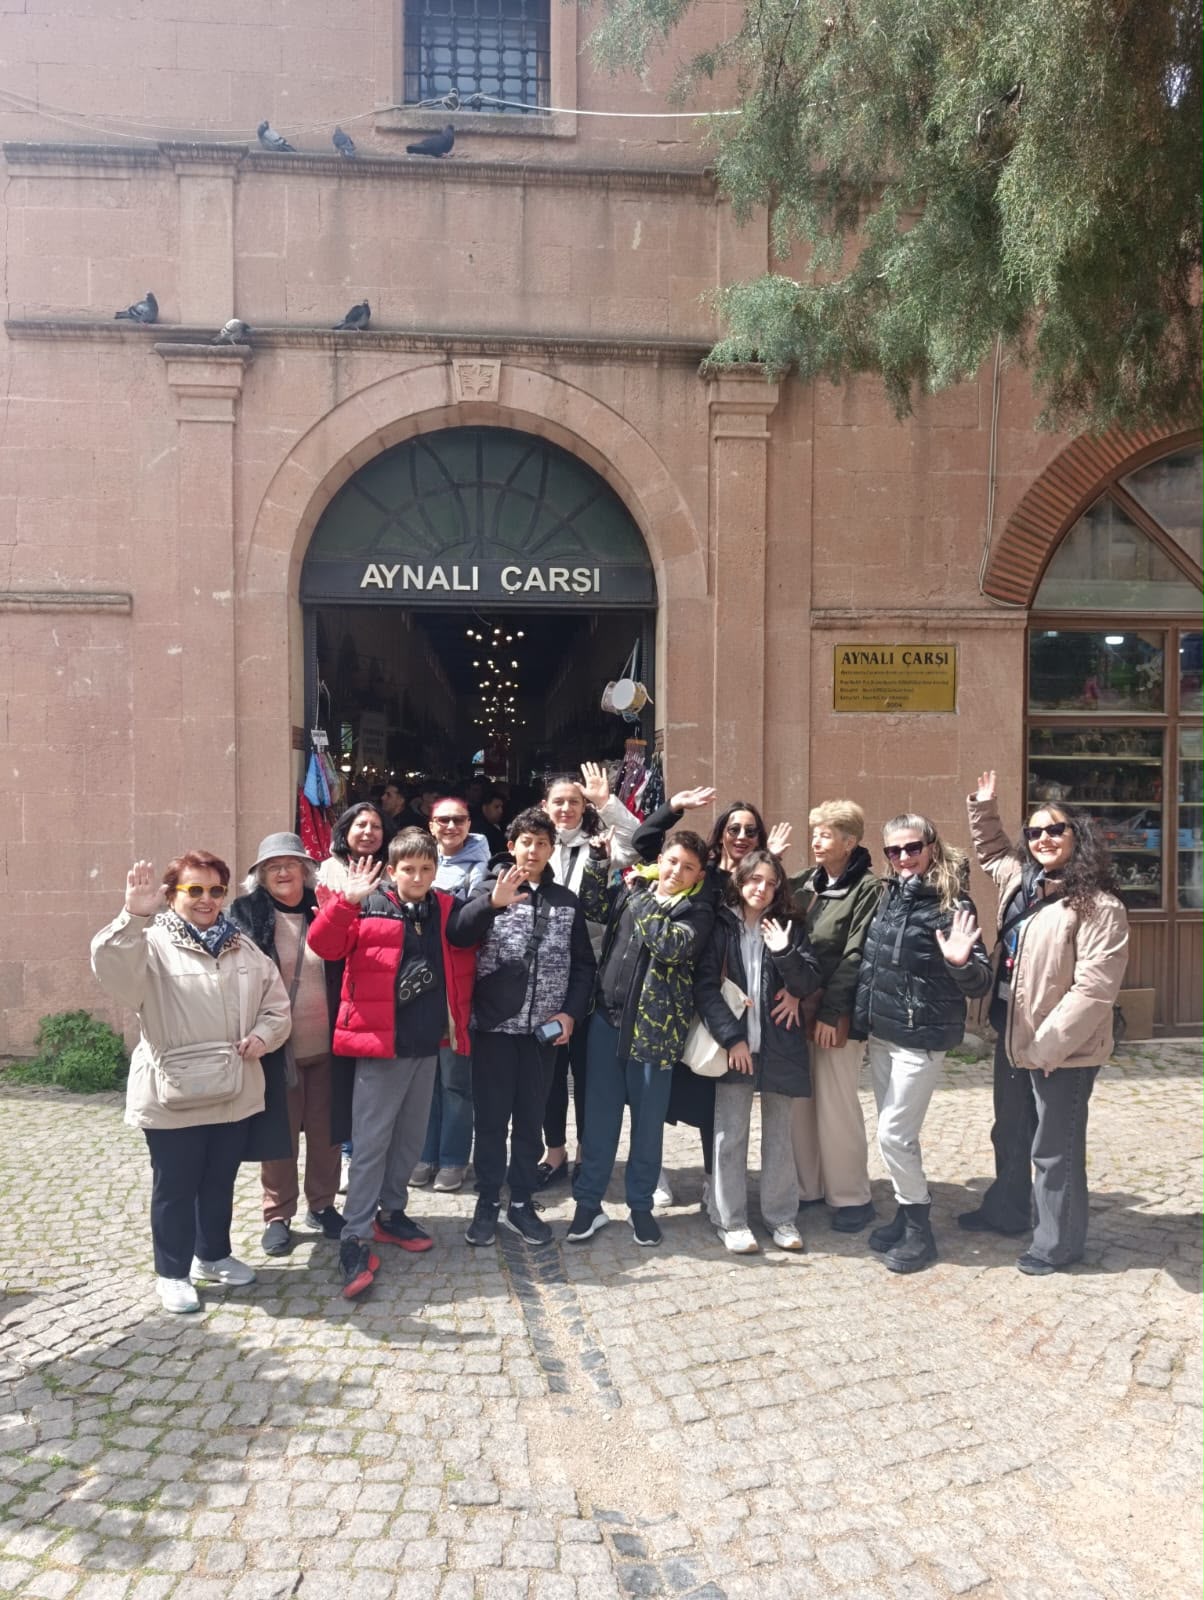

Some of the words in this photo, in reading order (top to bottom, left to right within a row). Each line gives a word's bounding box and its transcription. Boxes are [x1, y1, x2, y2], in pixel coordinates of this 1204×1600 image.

[360, 563, 479, 591] AYNALI
[500, 565, 600, 596] ÇARŞI
[841, 651, 894, 665] AYNALI
[902, 651, 949, 668] ÇARŞI
